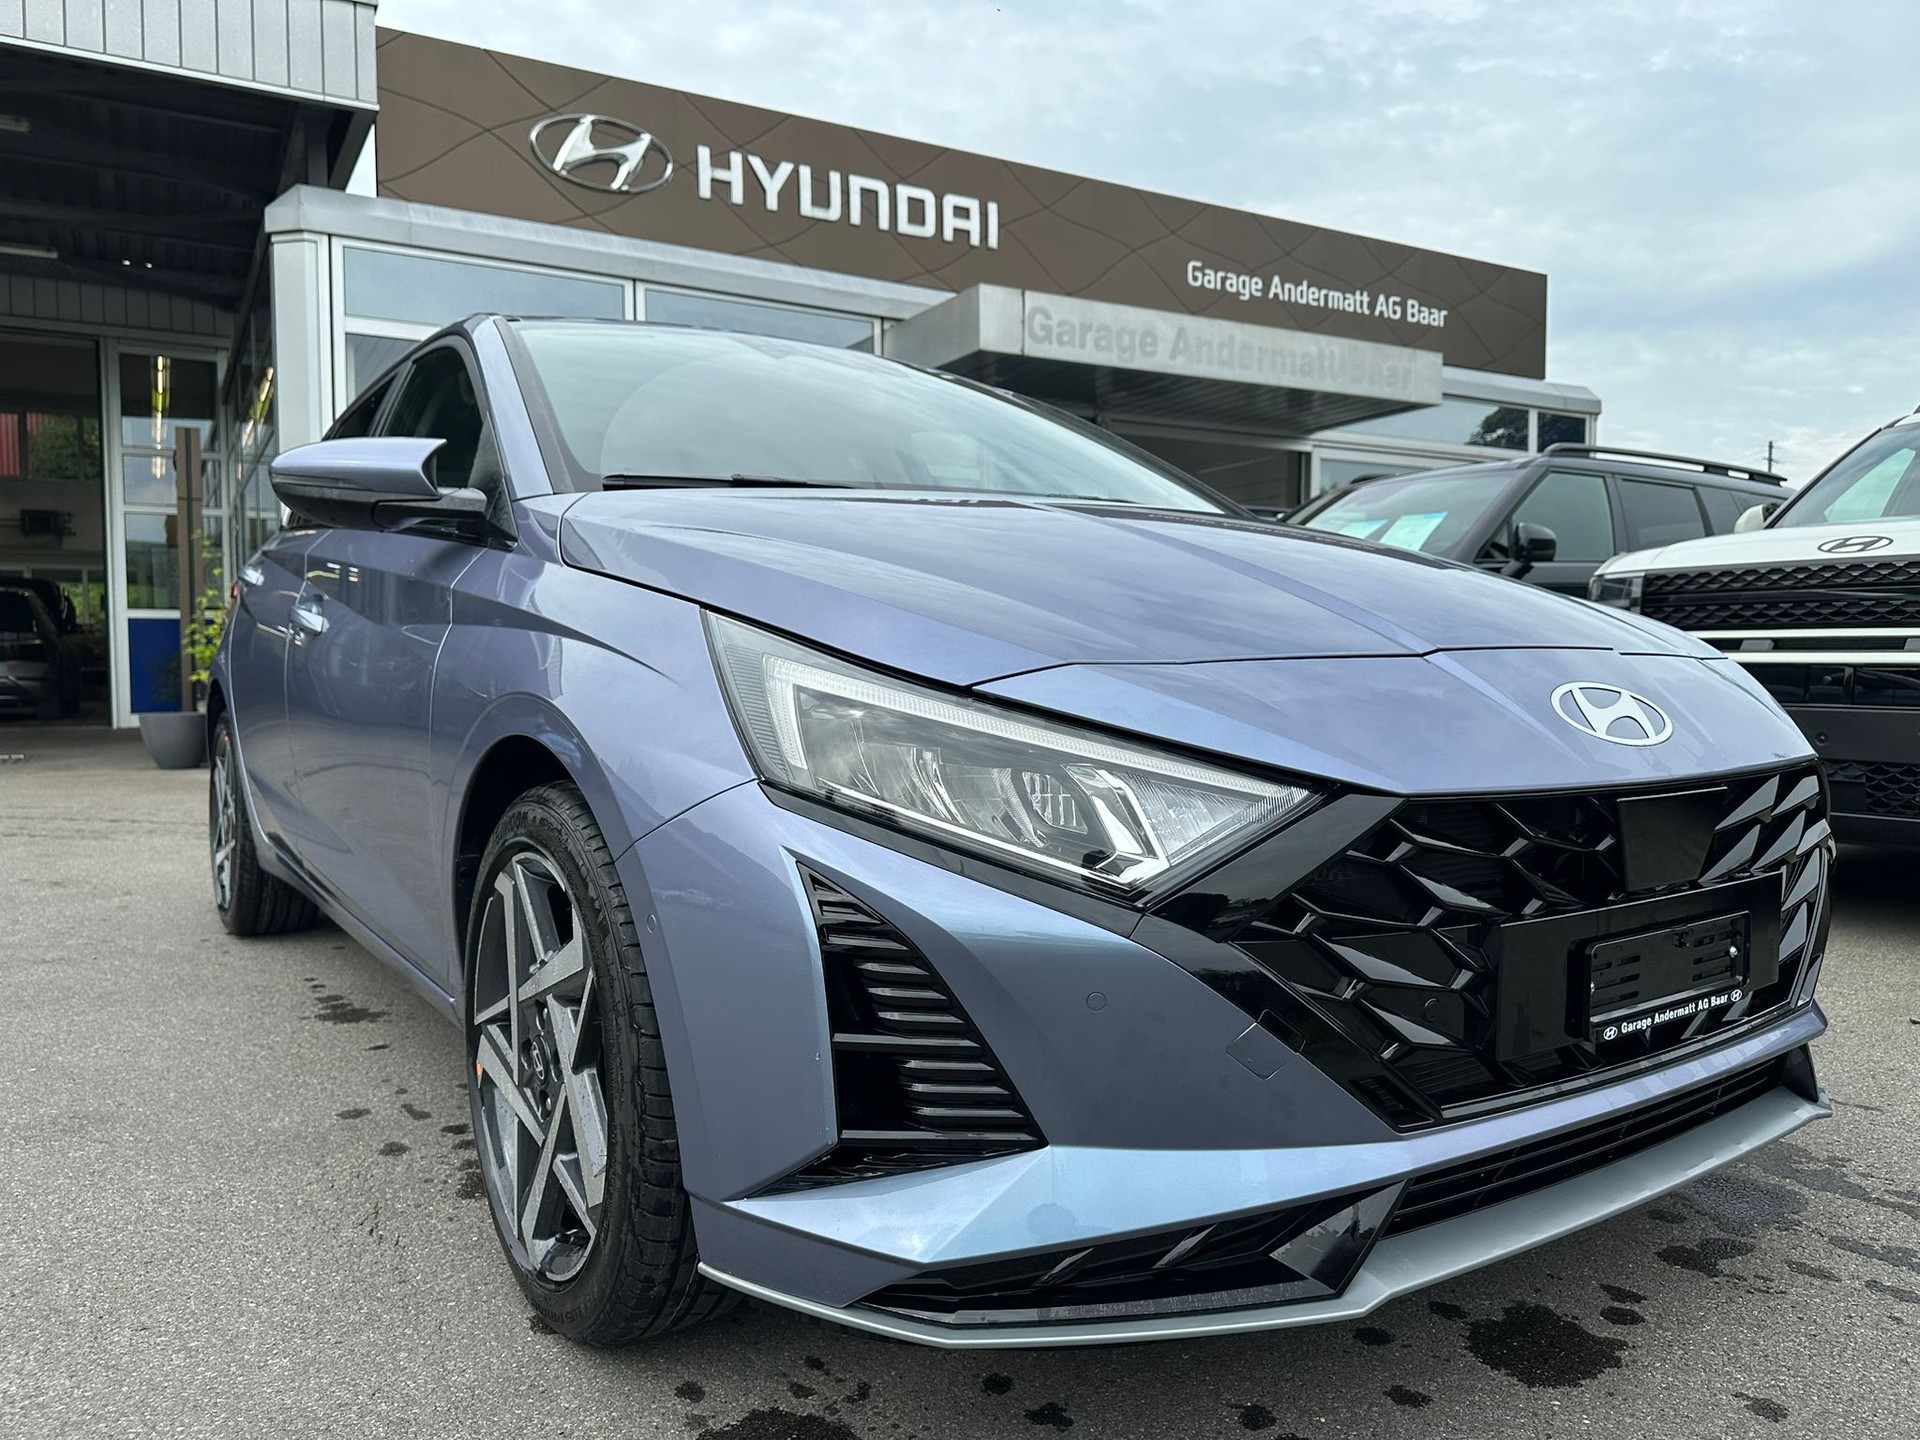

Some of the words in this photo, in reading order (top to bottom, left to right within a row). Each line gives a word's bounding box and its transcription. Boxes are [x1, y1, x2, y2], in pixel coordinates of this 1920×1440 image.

[696, 144, 999, 249] HYUNDAI
[1187, 260, 1263, 300] Garage
[1268, 275, 1371, 315] Andermatt
[1374, 296, 1402, 320] AG
[1406, 300, 1448, 328] Baar
[1027, 306, 1159, 363] Garage
[1621, 1017, 1652, 1034] Garage
[1654, 1002, 1696, 1024] Andermatt
[1698, 998, 1709, 1012] AG
[1711, 994, 1729, 1006] Baar
